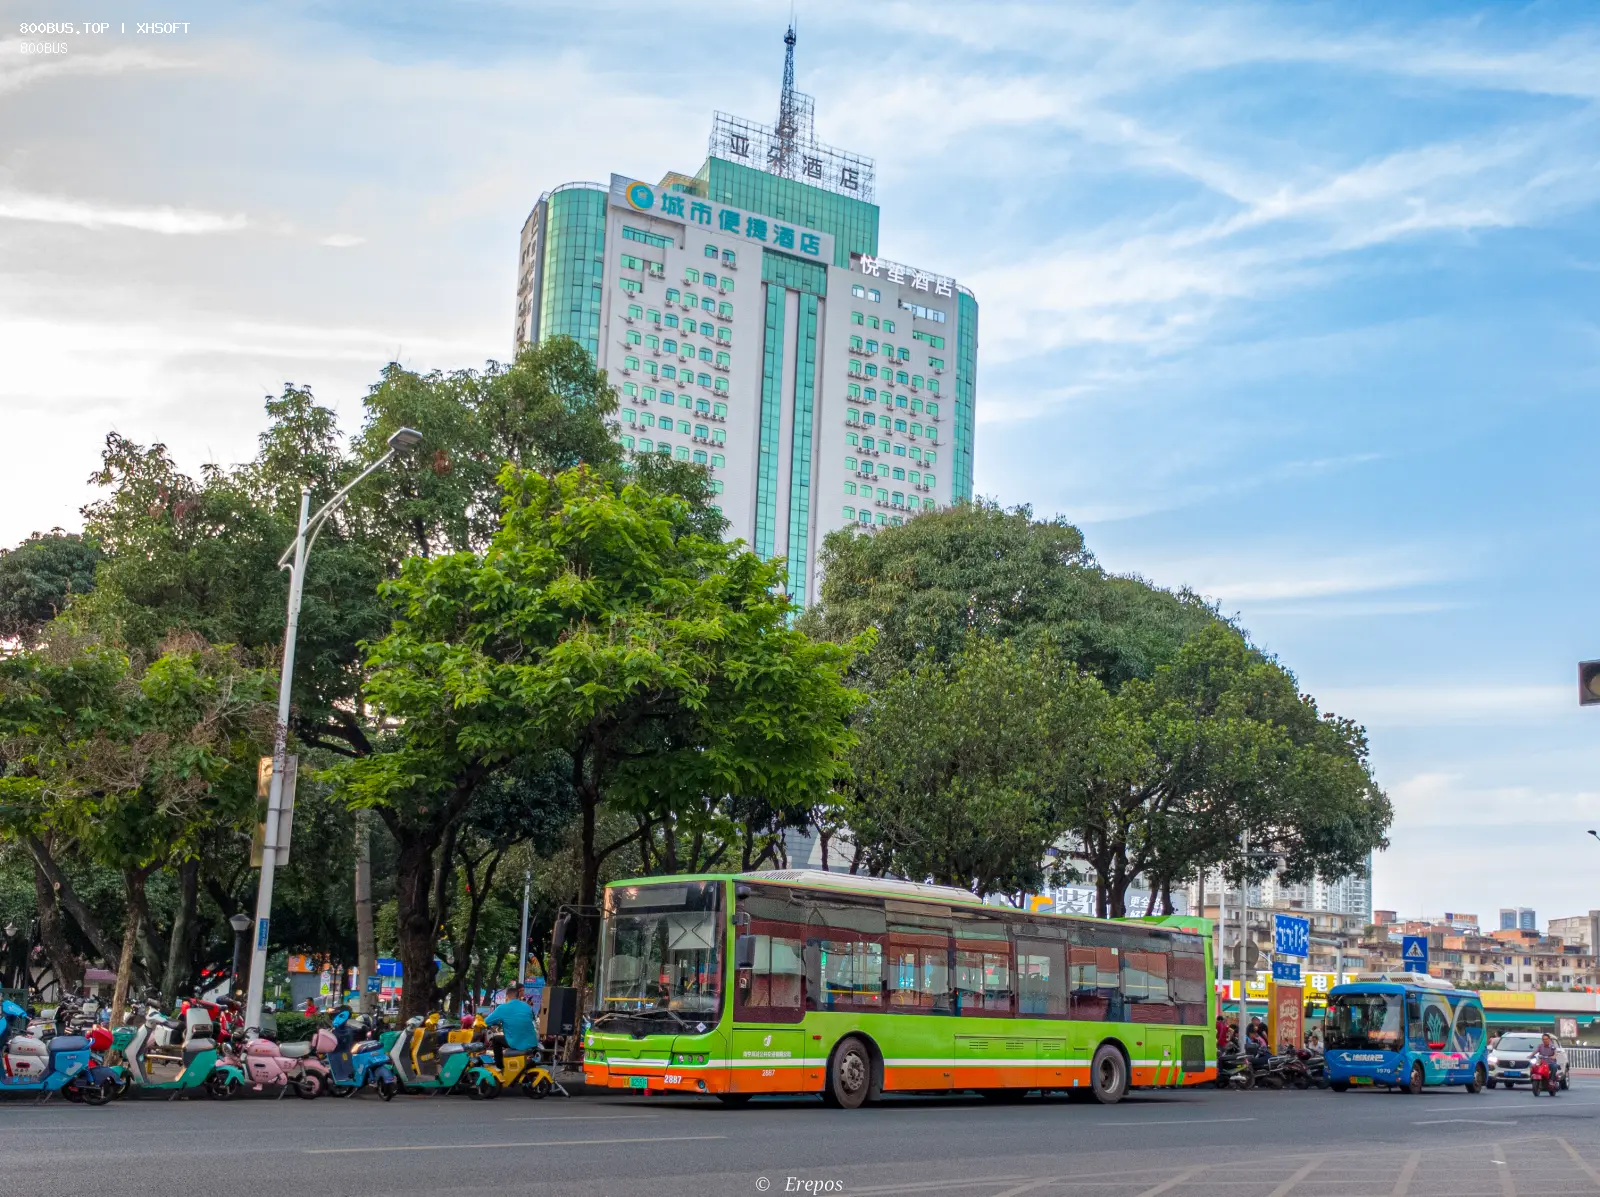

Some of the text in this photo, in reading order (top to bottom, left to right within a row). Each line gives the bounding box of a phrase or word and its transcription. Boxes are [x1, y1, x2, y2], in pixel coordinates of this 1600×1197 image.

[730, 134, 860, 191] 亚朵酒店
[660, 191, 822, 256] 城市便捷酒店
[664, 1074, 682, 1084] 2887
